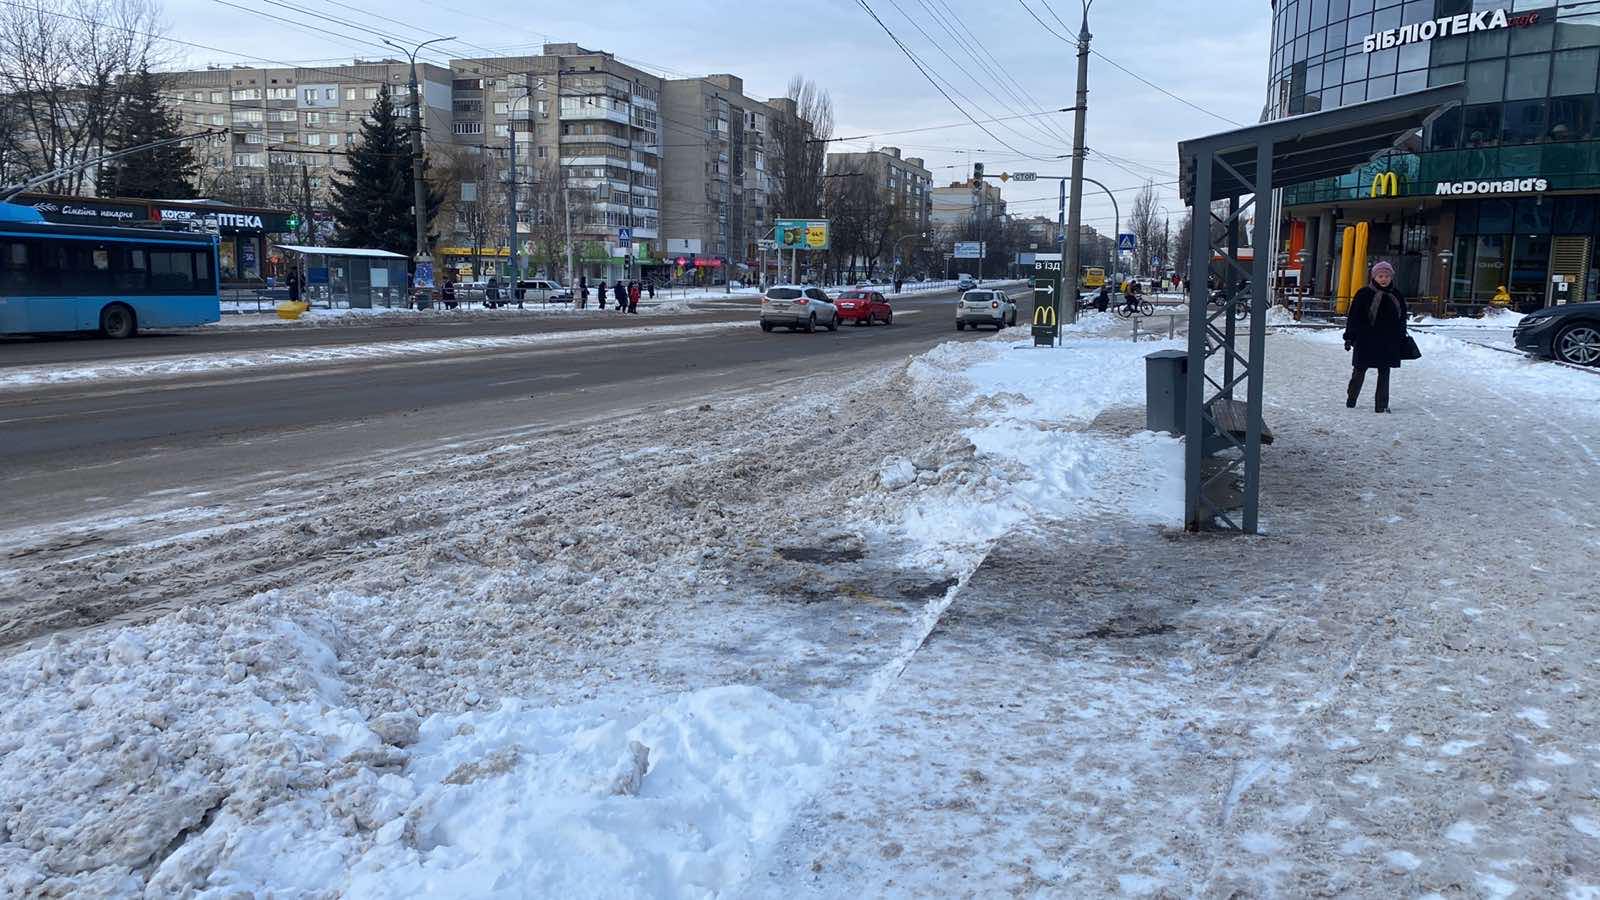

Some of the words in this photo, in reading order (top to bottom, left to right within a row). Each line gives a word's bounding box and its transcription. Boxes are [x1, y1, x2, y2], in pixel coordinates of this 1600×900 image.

[1363, 9, 1508, 53] БІБЛІОТЕКА
[1015, 173, 1035, 181] СТОП
[1435, 178, 1547, 195] McDonald's
